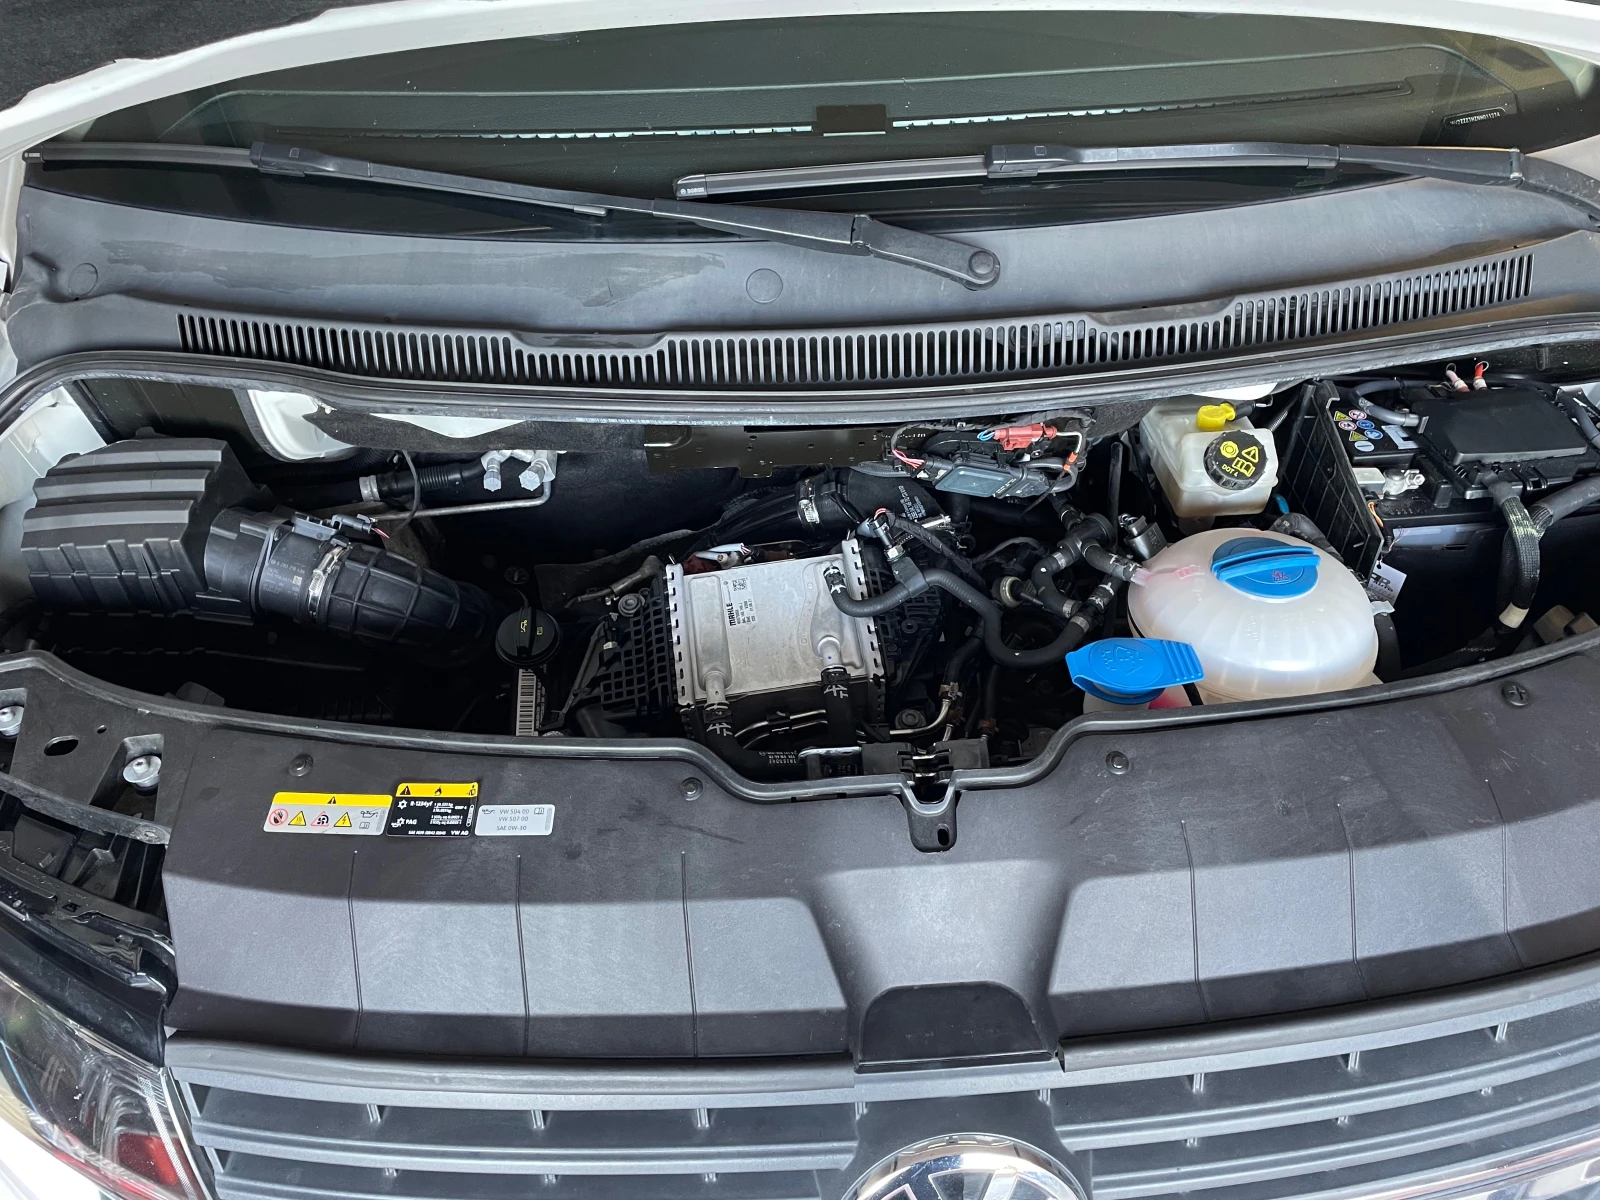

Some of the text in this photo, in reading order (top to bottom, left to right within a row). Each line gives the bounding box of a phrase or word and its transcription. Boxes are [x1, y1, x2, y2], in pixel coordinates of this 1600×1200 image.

[1222, 463, 1235, 474] DOT
[726, 602, 736, 626] MAHLE
[410, 800, 434, 808] R-1234yf
